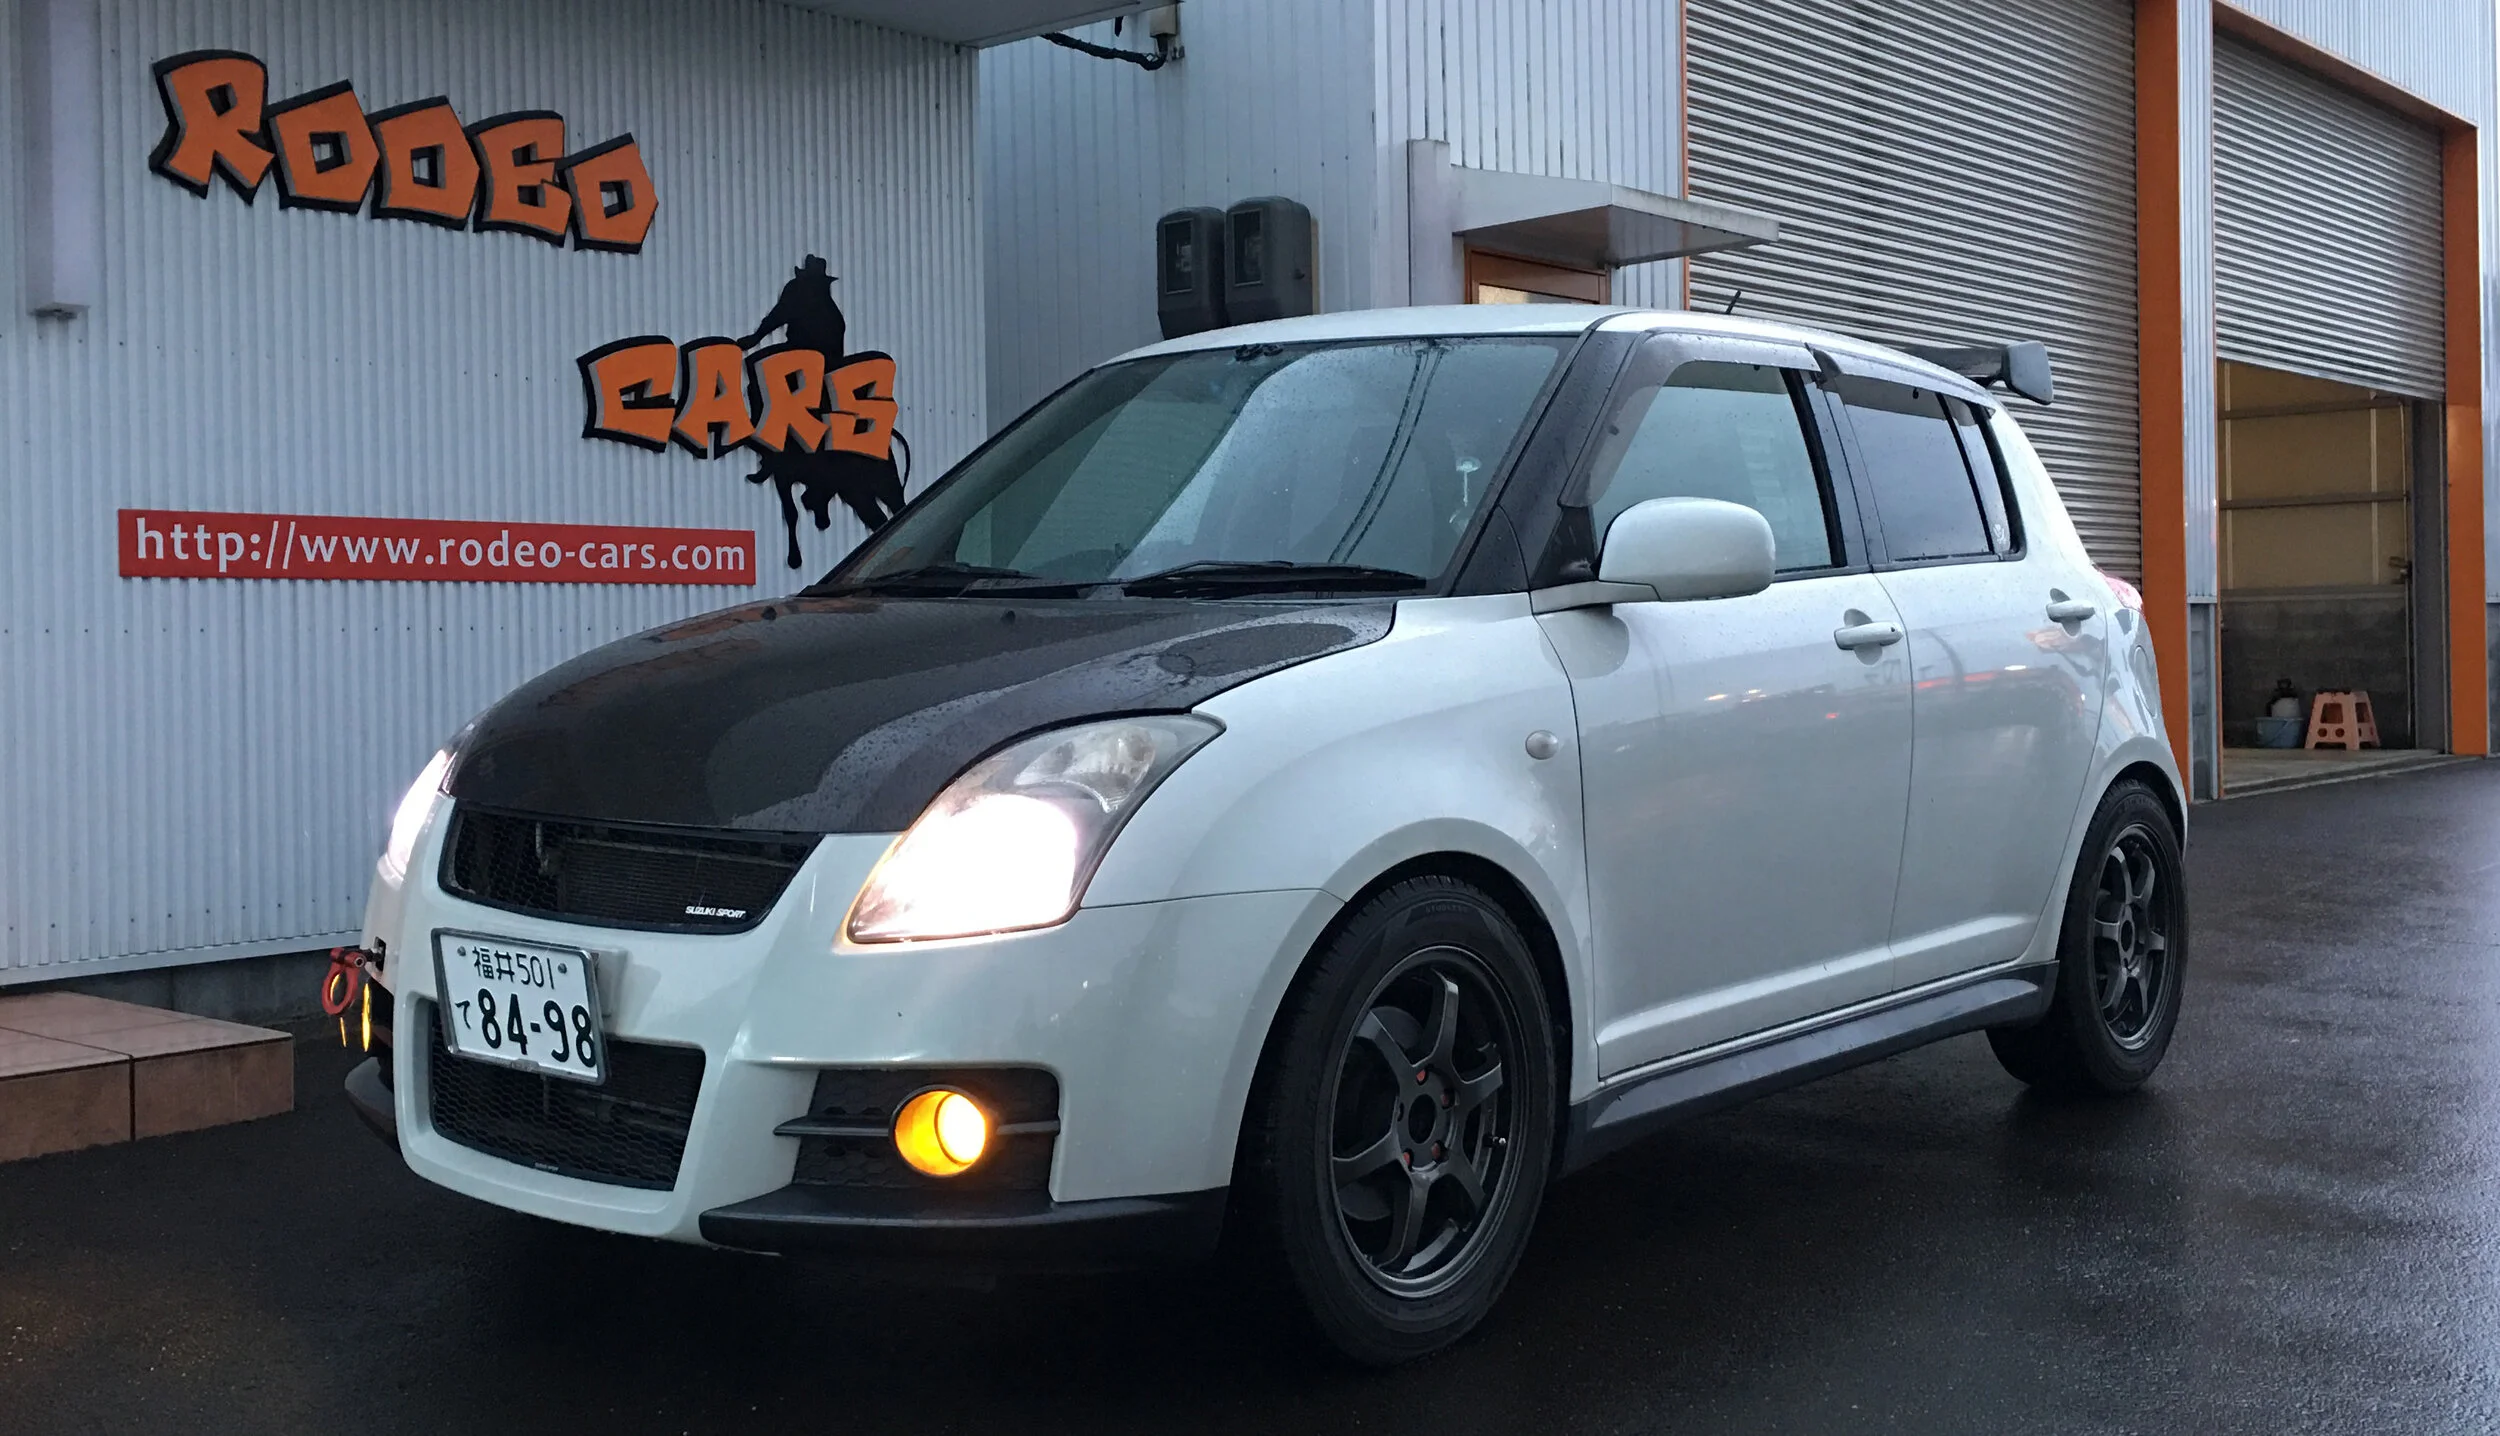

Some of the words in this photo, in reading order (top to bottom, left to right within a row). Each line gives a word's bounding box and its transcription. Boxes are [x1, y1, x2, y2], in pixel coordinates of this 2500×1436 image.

[149, 49, 658, 254] RODEO
[576, 335, 898, 460] CARS
[136, 519, 746, 573] http://www.rodeo-cars.com
[685, 905, 716, 916] SUZUKI
[716, 908, 746, 918] SPORT
[478, 988, 596, 1068] 84-98
